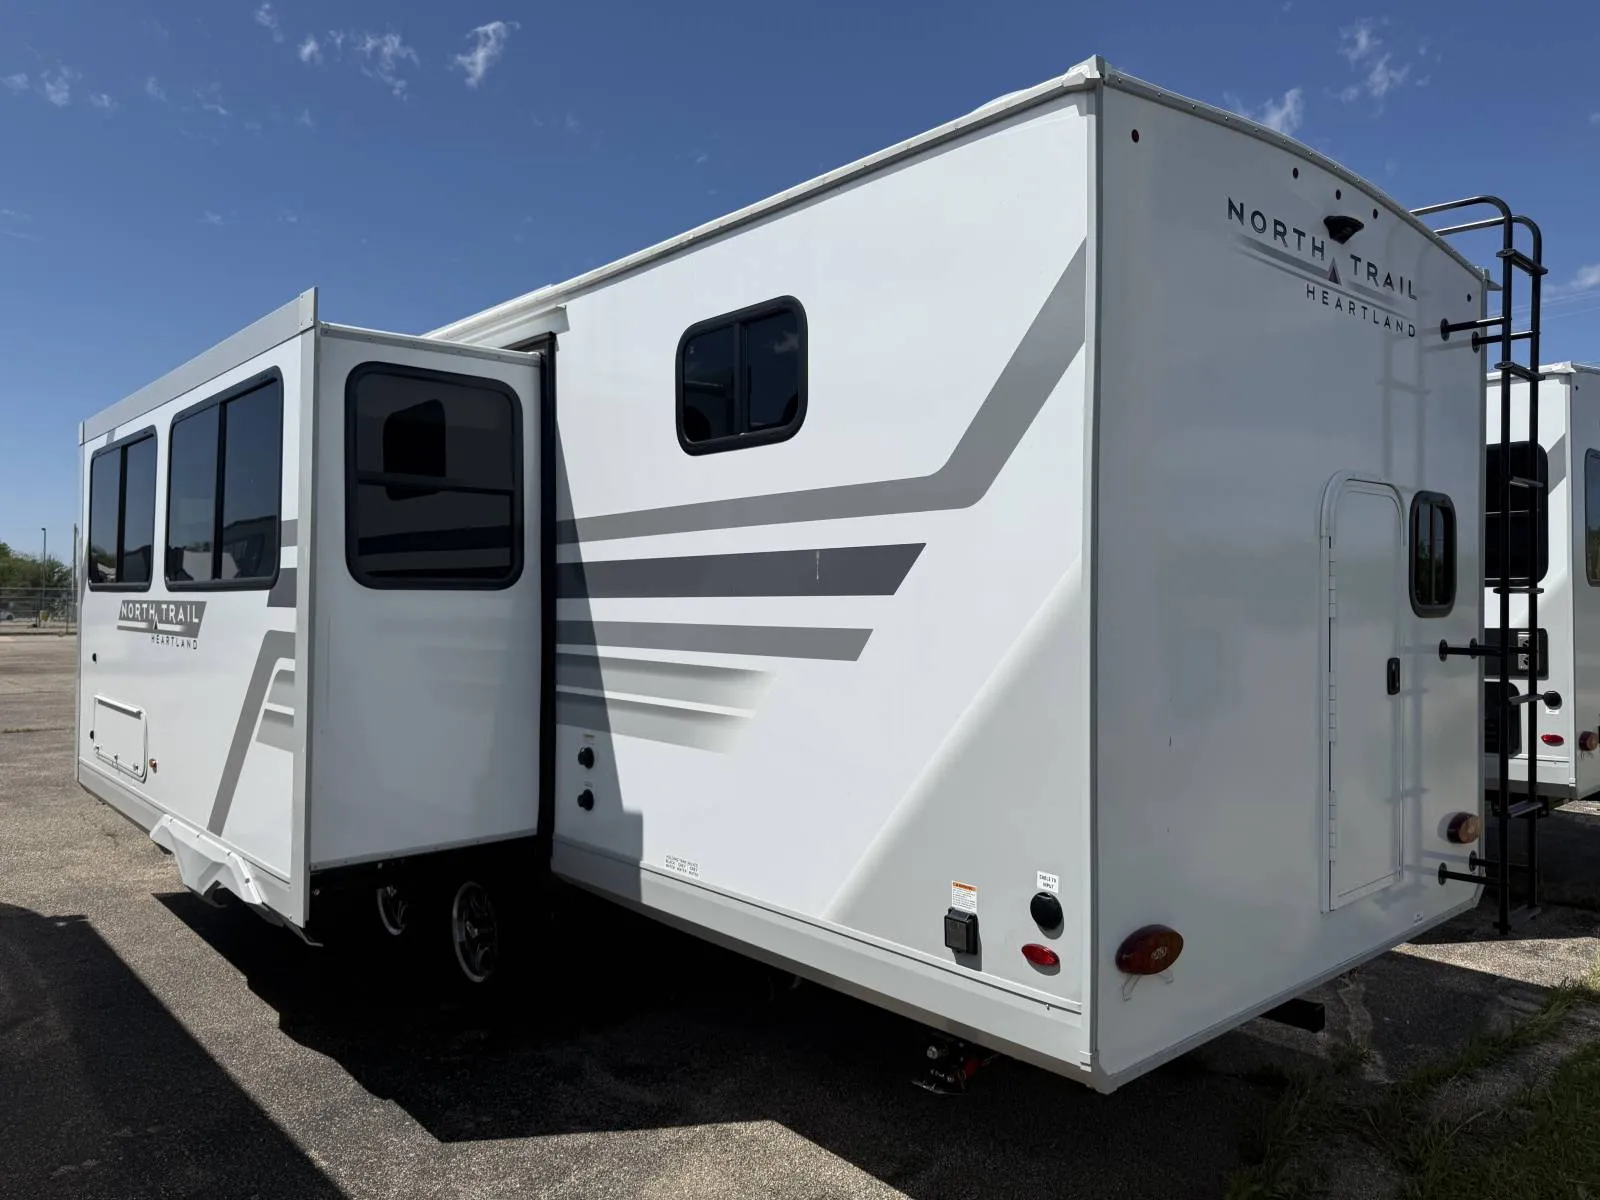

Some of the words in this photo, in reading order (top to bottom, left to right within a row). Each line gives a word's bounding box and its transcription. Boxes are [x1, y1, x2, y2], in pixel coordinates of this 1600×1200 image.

[1227, 196, 1326, 261] NORTH
[1349, 254, 1418, 301] TRAIL
[1306, 283, 1416, 338] HEARTLAND
[121, 602, 156, 621] NORTH
[161, 603, 200, 624] TRAIL
[151, 633, 198, 650] HEARTLAND
